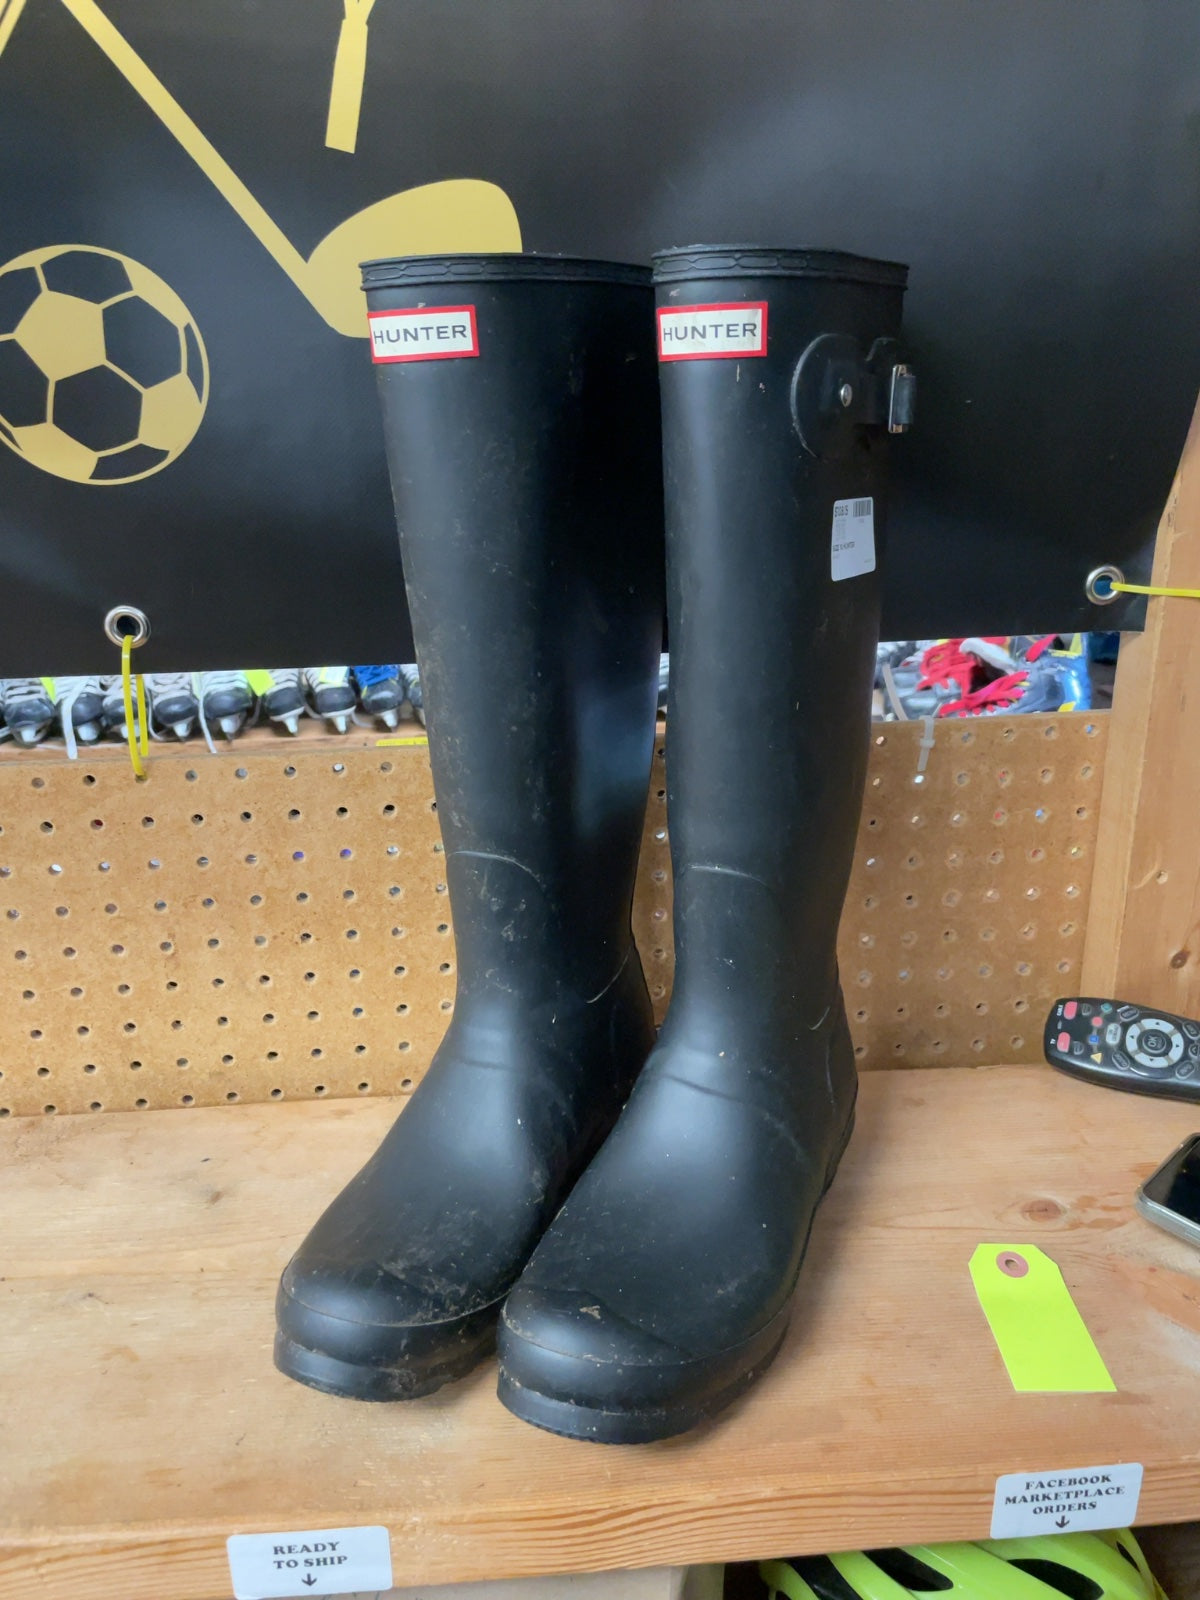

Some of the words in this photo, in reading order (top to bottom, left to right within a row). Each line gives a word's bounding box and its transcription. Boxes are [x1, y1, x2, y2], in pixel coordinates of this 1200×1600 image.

[373, 324, 467, 344] HUNTER
[663, 323, 757, 342] HUNTER
[1148, 1035, 1157, 1047] OK
[1025, 1473, 1112, 1491] FACEBOOK
[1005, 1486, 1126, 1505] MARKETPLACE
[1032, 1501, 1098, 1515] ORDERS
[272, 1541, 341, 1555] READY
[273, 1559, 299, 1569] TO
[303, 1555, 348, 1567] SHIP
